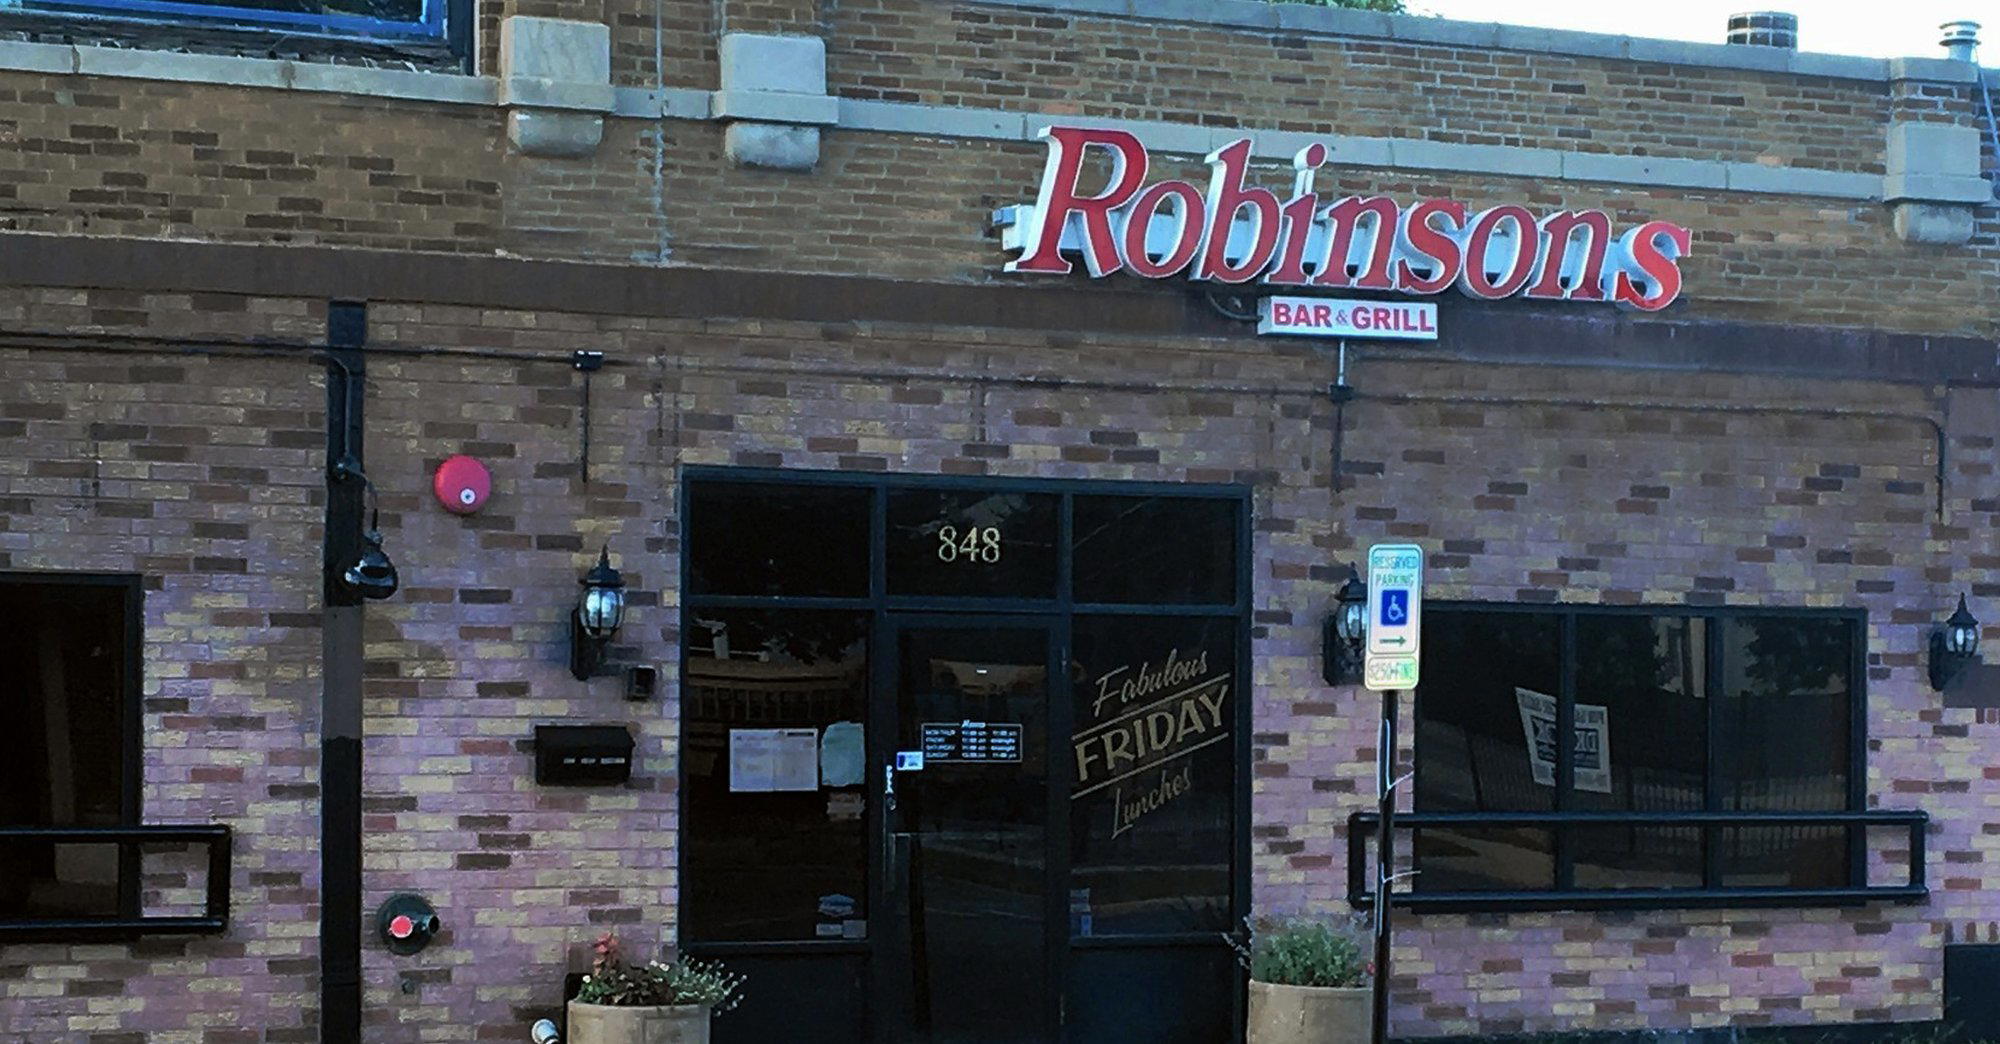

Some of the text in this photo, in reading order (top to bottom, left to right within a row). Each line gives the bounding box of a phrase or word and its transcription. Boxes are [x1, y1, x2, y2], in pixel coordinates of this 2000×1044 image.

[1001, 125, 1692, 312] Robinsons
[1273, 303, 1435, 332] BAR & GRILL
[938, 525, 1001, 562] 848
[1092, 648, 1208, 717] Fabulous
[1074, 684, 1229, 782] FRIDAY
[1111, 767, 1192, 840] Lunches
